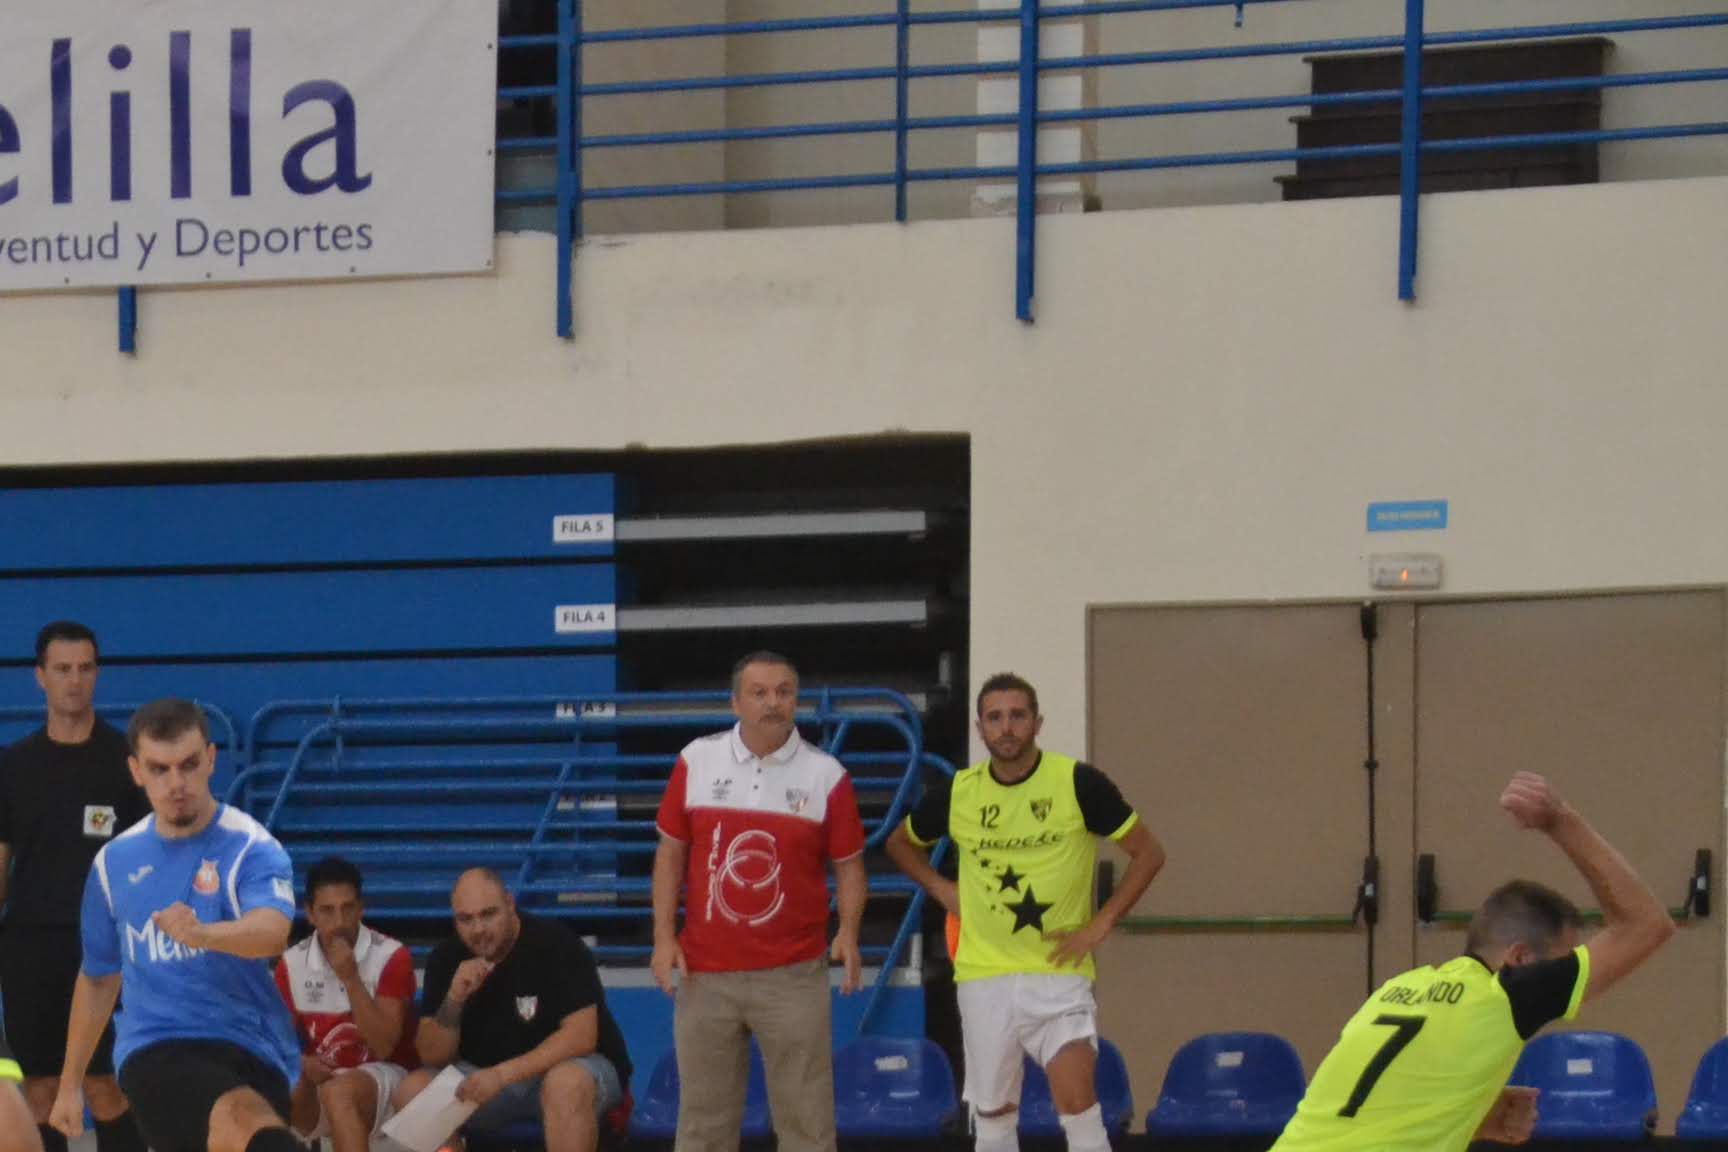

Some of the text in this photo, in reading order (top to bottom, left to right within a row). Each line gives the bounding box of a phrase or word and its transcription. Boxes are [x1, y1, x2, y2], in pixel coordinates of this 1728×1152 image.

[136, 231, 158, 271] y
[175, 217, 374, 268] Deportes
[561, 520, 604, 534] FILA 5
[563, 610, 606, 624] FILA 4
[563, 702, 594, 714] FIA
[978, 803, 1001, 830] 12
[1335, 1013, 1428, 1119] 7
